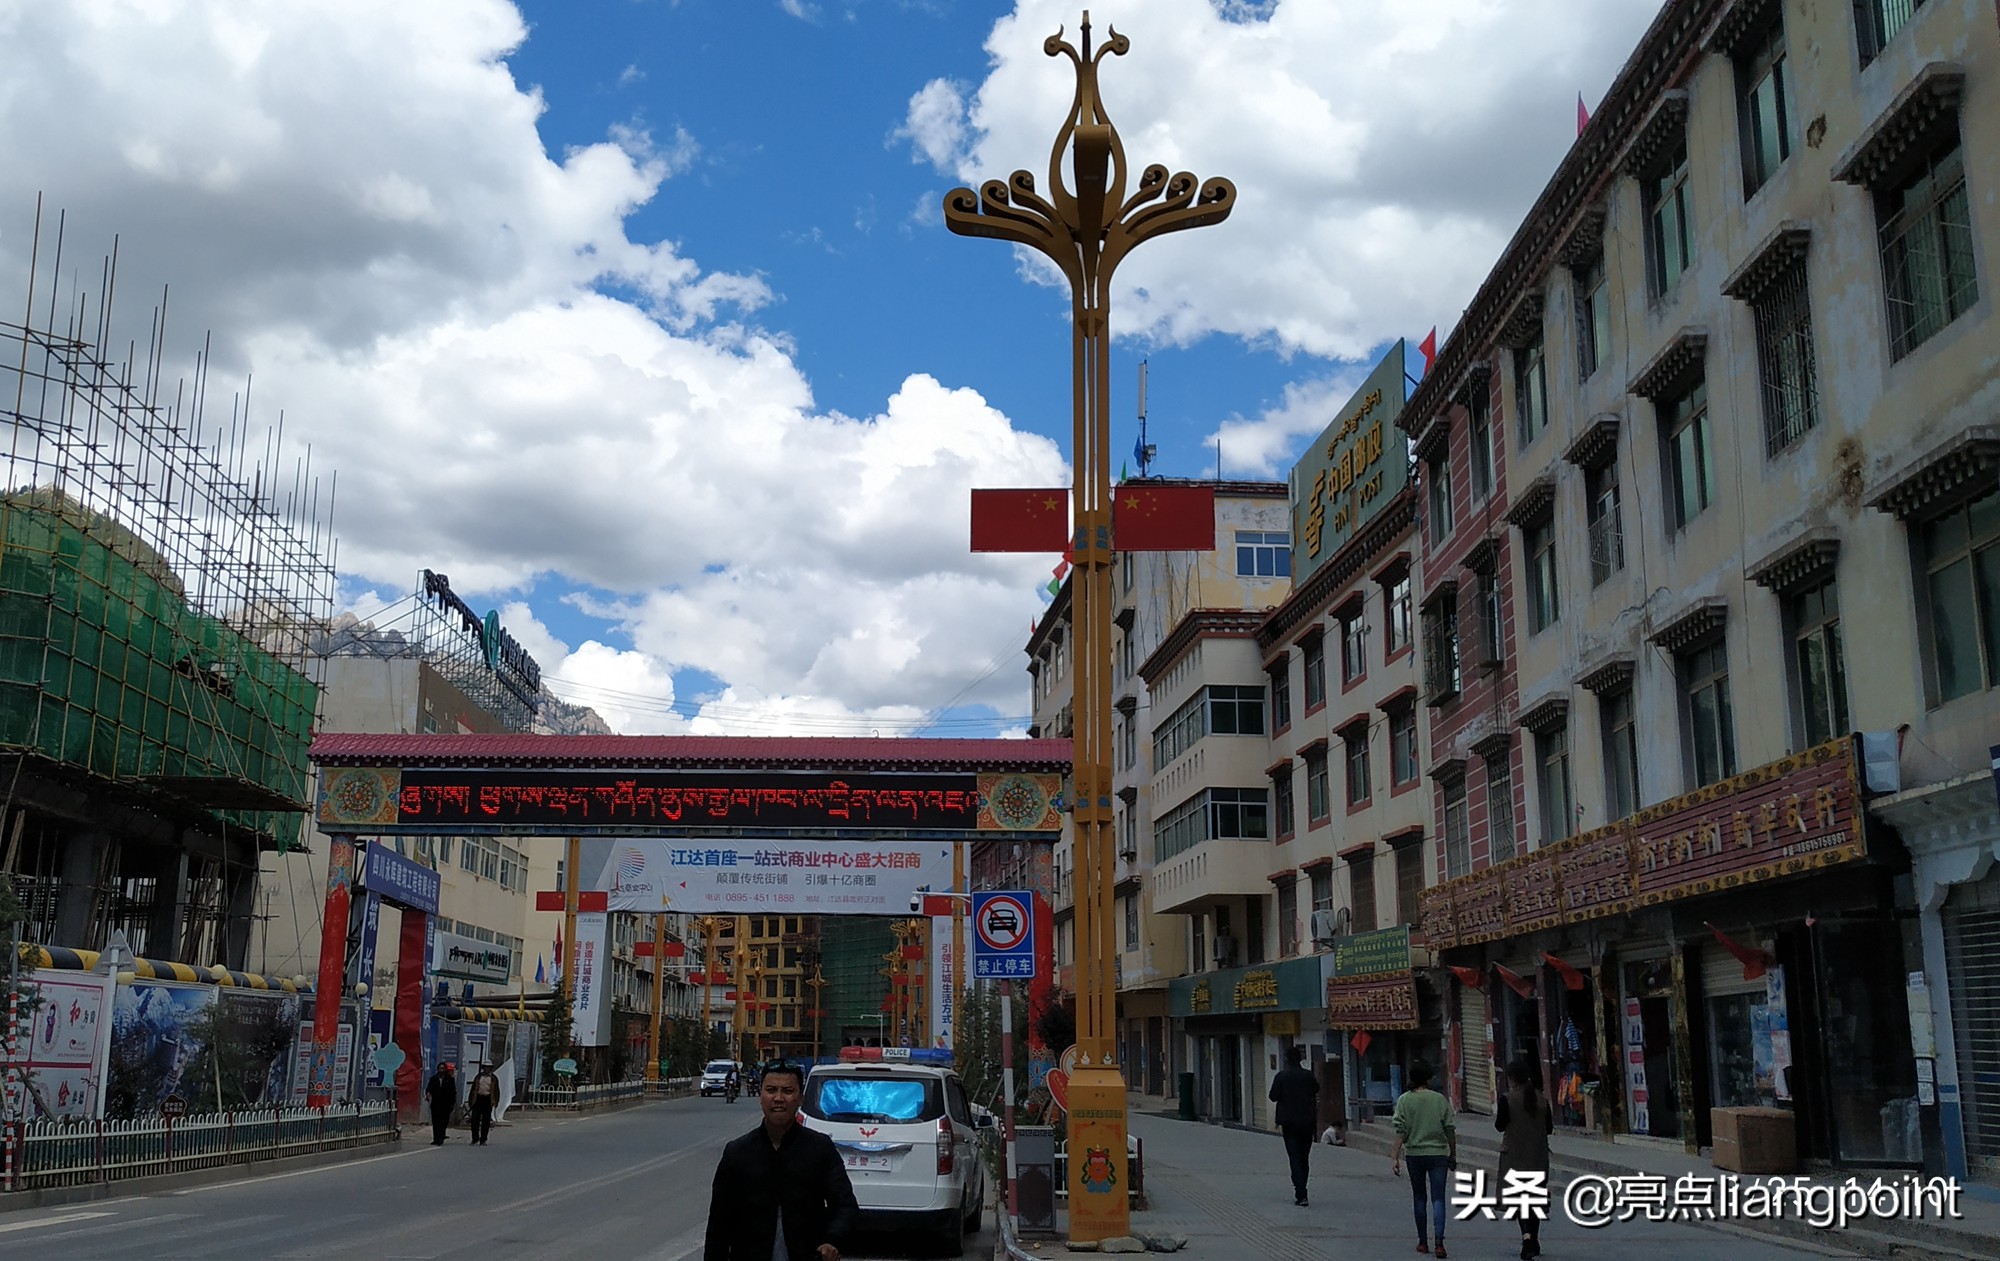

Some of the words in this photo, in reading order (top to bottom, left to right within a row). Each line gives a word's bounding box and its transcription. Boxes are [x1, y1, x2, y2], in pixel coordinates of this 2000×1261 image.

[1327, 420, 1383, 504] 中国邮政
[1360, 471, 1382, 508] POST
[671, 849, 921, 869] 江达首座一站式商业中心盛大招商
[716, 872, 788, 885] 颠覆传统街铺
[805, 874, 876, 886] 引爆十亿商圈
[580, 940, 594, 1011] 创造江城商业名片
[941, 943, 953, 1024] 引领江城生活方式
[977, 958, 1031, 974] 禁止停车
